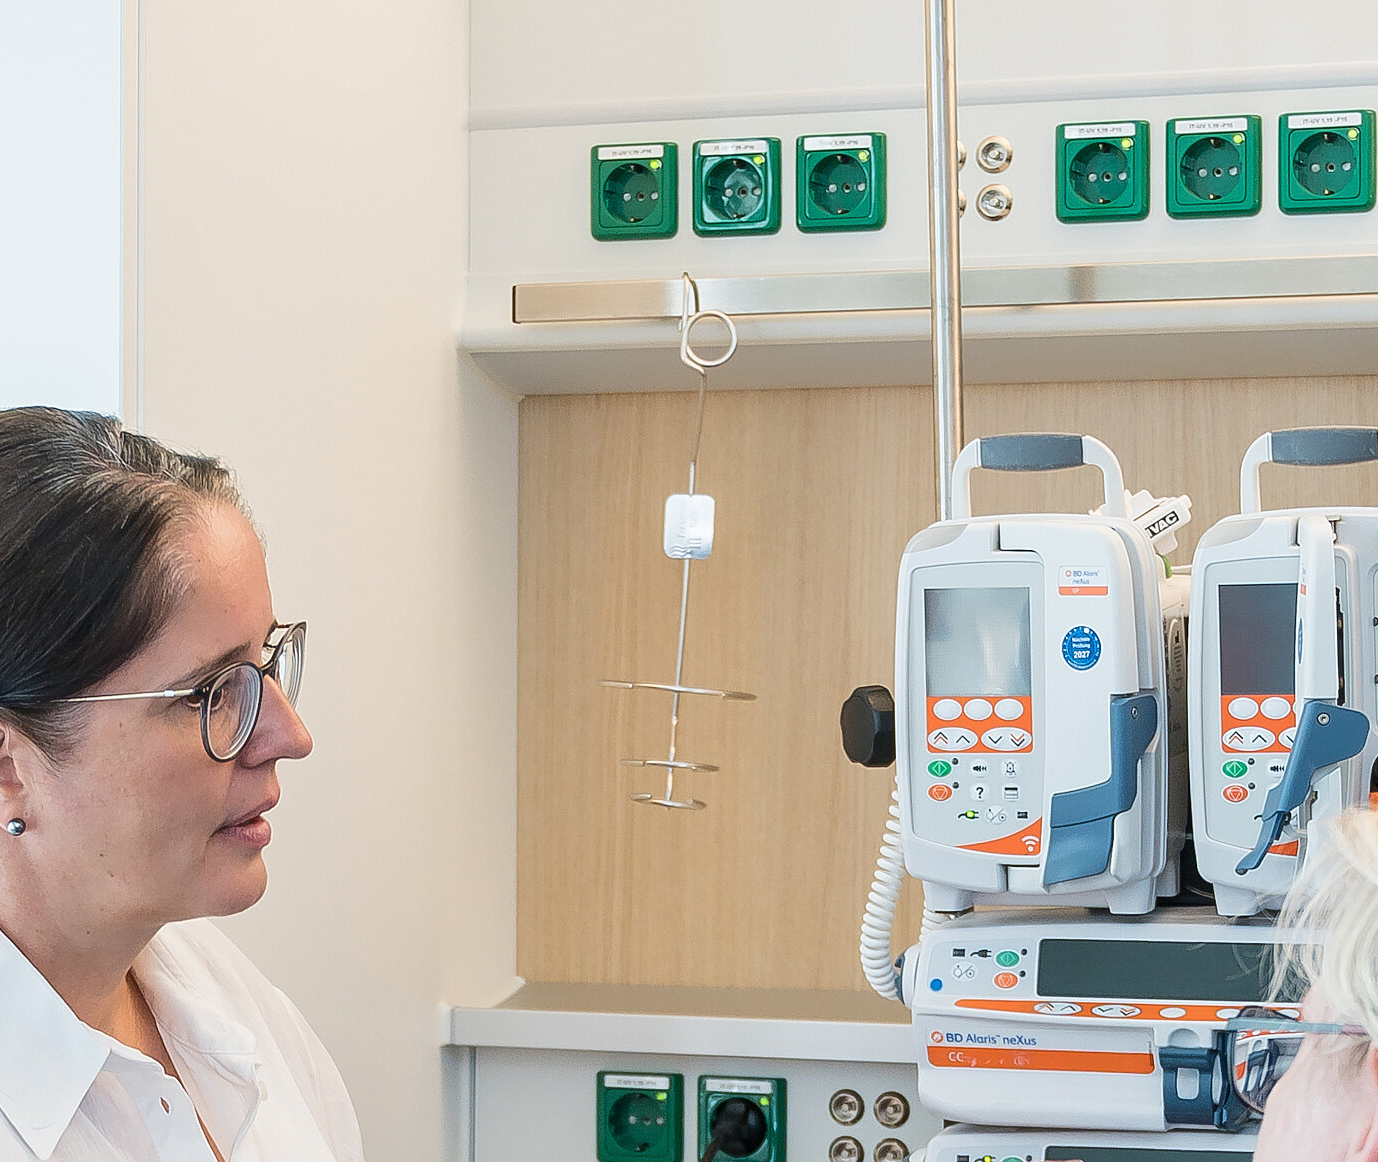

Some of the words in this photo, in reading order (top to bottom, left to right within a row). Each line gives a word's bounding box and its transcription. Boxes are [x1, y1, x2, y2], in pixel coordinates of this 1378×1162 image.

[1145, 510, 1179, 538] IVAC
[1073, 650, 1090, 659] 2027
[945, 1032, 963, 1043] BD
[1002, 1035, 1037, 1046] neXus
[948, 1051, 964, 1063] CC
